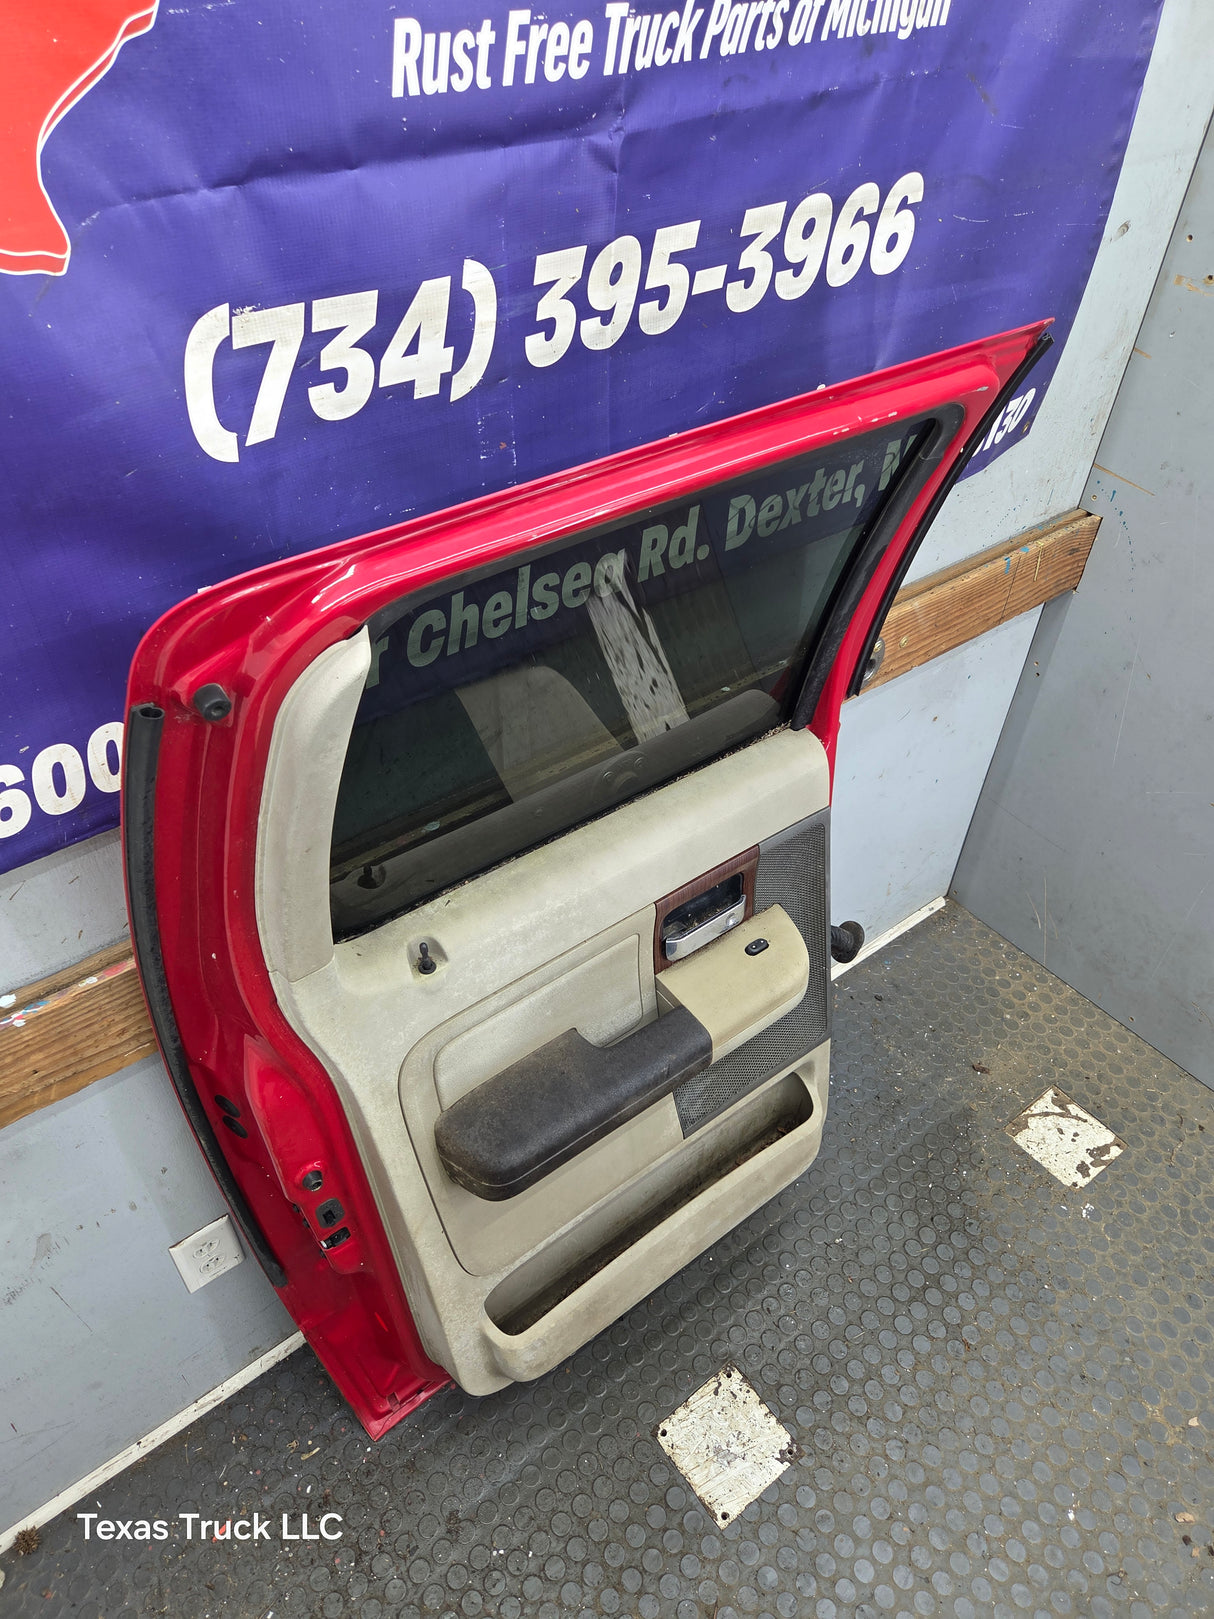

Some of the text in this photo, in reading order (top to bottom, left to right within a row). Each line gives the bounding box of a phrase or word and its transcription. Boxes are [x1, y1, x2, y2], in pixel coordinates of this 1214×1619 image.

[391, 17, 496, 98] Rust
[502, 9, 594, 87] Free
[603, 0, 704, 76] Truck
[699, 0, 789, 60] Parts
[787, 0, 824, 47] of
[184, 172, 925, 463] (734) 395-3966
[406, 548, 628, 667] Chelsea
[637, 505, 710, 583] Rd.
[724, 459, 866, 552] Dexter,
